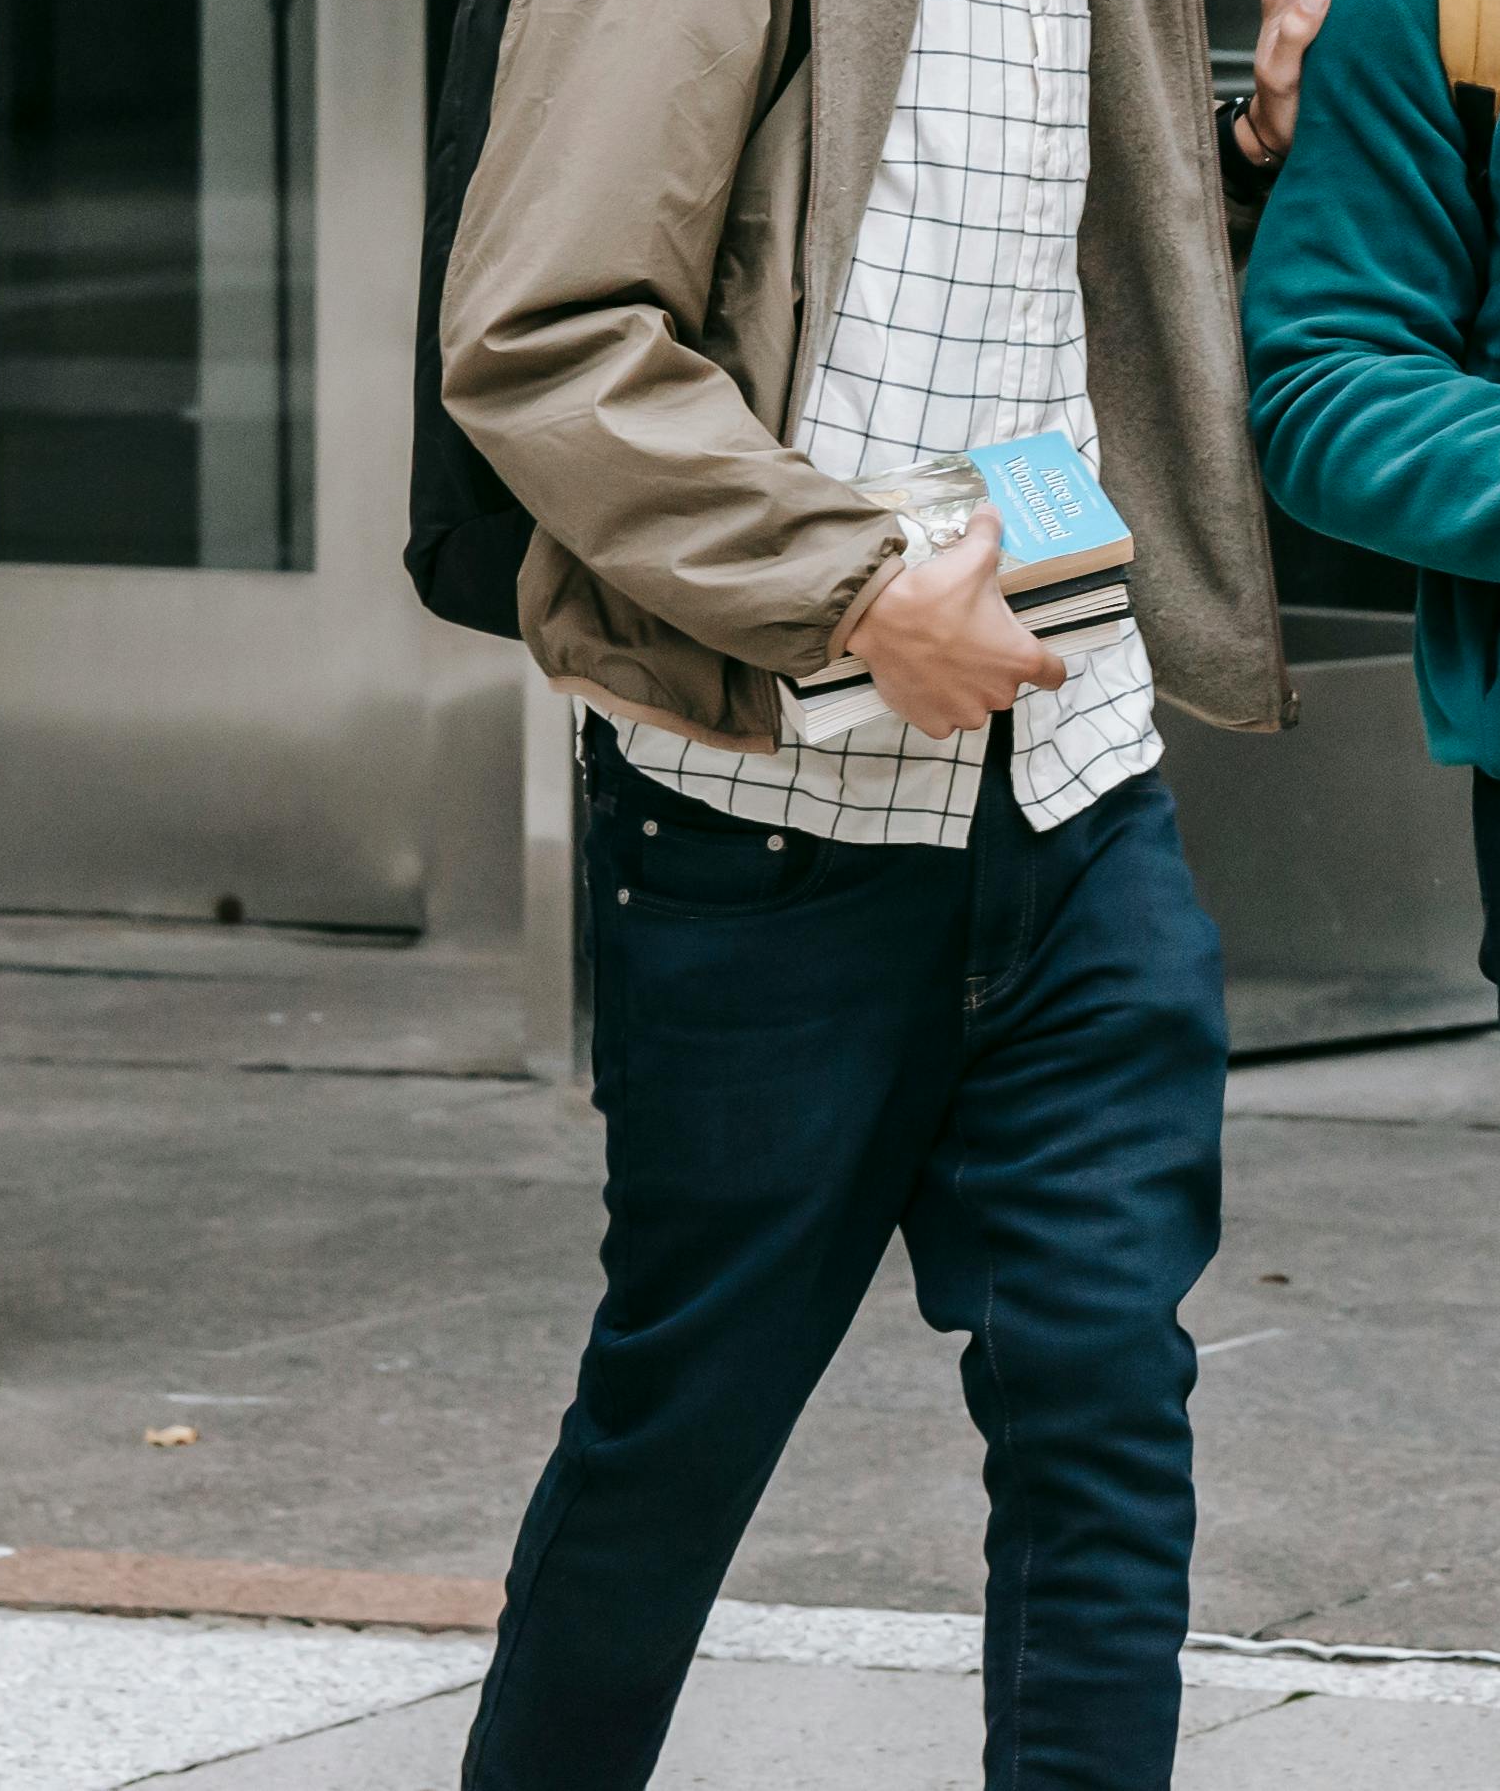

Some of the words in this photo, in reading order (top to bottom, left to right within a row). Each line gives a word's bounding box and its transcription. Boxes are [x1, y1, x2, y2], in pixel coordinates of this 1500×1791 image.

[1004, 455, 1074, 541] Wonderland
[1038, 467, 1072, 504] Alice
[1061, 500, 1083, 519] in
